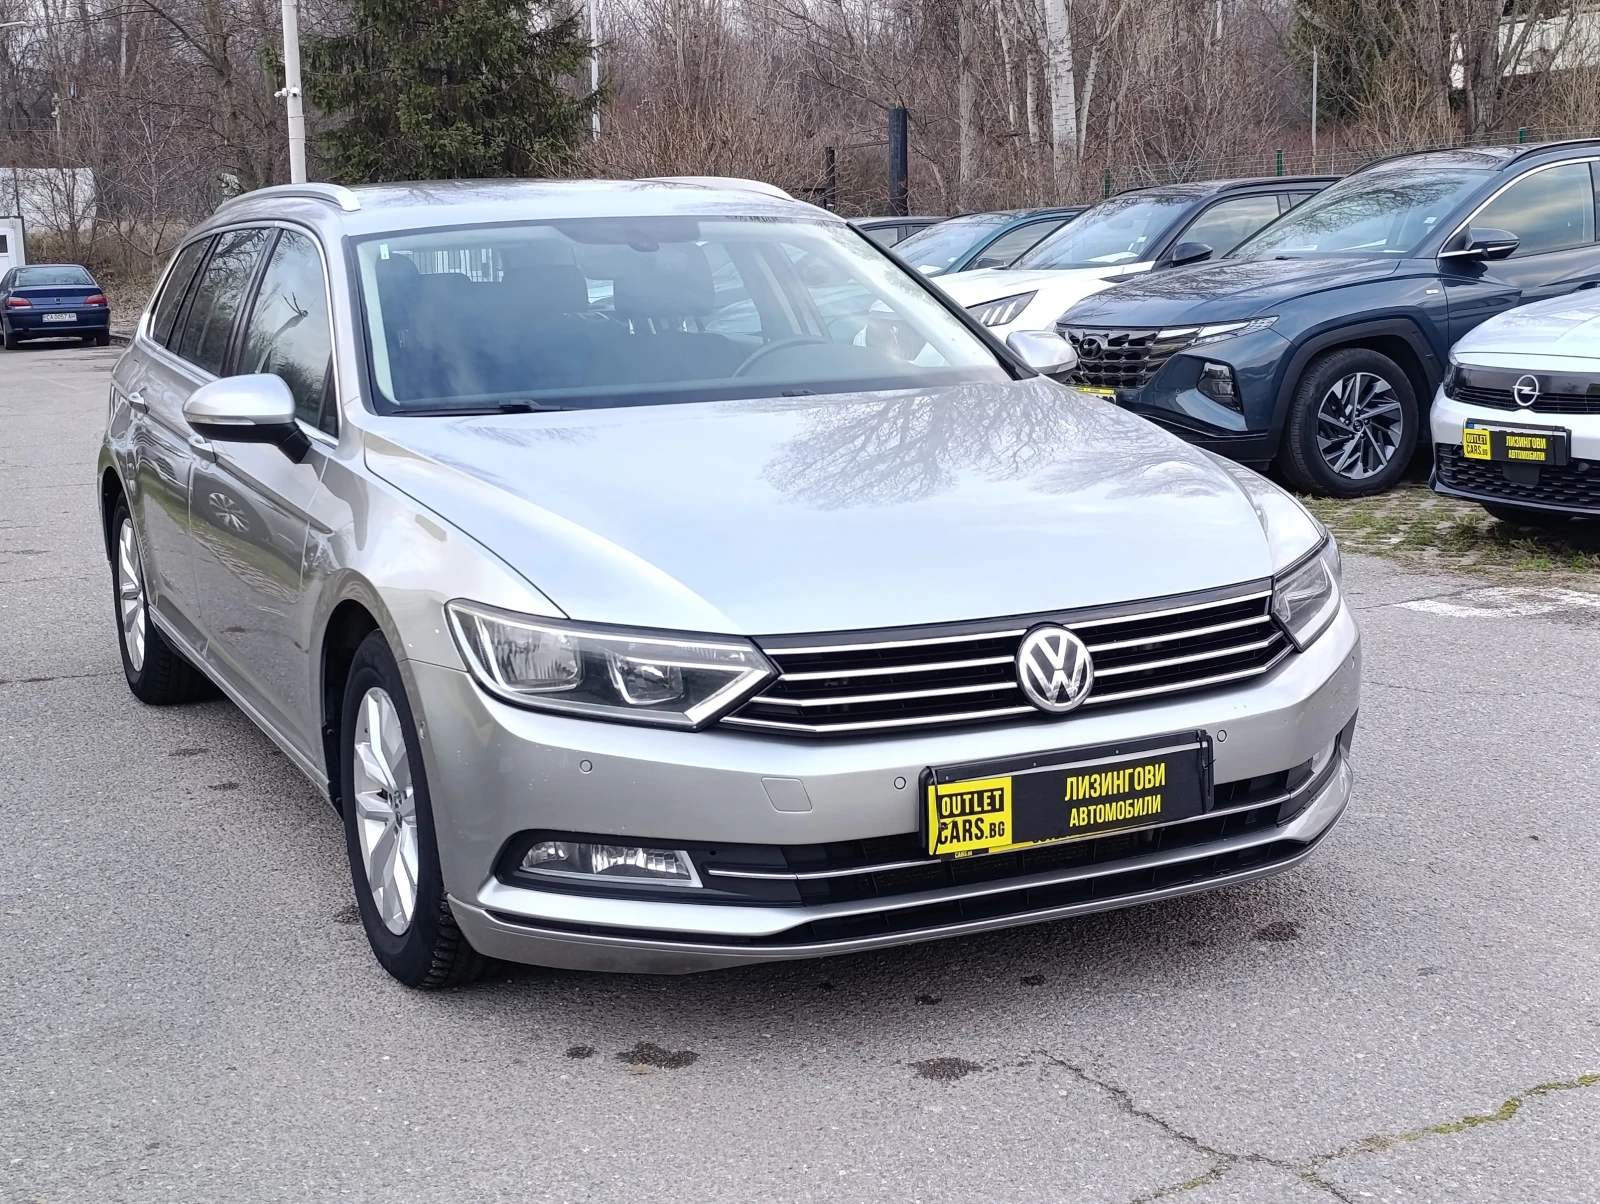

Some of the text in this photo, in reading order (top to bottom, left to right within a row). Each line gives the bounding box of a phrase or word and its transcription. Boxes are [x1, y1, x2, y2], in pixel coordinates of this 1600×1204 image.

[1466, 434, 1487, 444] OUTLET
[1505, 435, 1546, 449] ЛИЗИНГОВИ
[1508, 449, 1546, 461] АВТОМОБИЛИ
[1064, 762, 1166, 802] ЛИЗИНГОВИ
[941, 790, 1002, 816] OUTLET
[1069, 794, 1162, 828] АВТОМОБИЛИ
[938, 817, 1006, 845] CARS.BG
